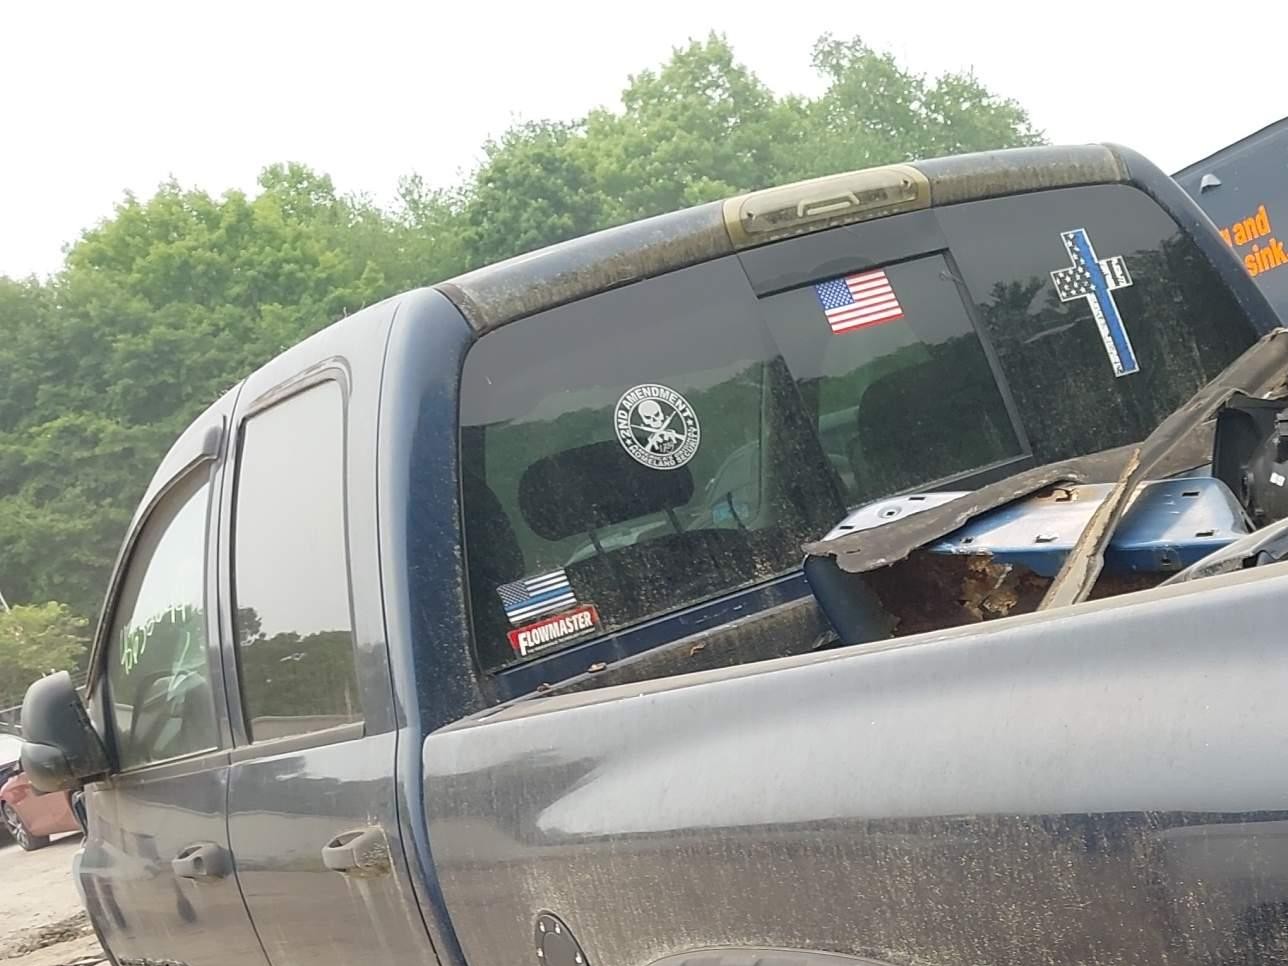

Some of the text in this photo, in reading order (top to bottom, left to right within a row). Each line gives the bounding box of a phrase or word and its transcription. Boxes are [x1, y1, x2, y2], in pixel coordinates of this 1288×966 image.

[1232, 204, 1271, 246] and
[617, 386, 694, 439] 2ND AMENDMENT
[518, 611, 593, 656] FLOWMASTER
